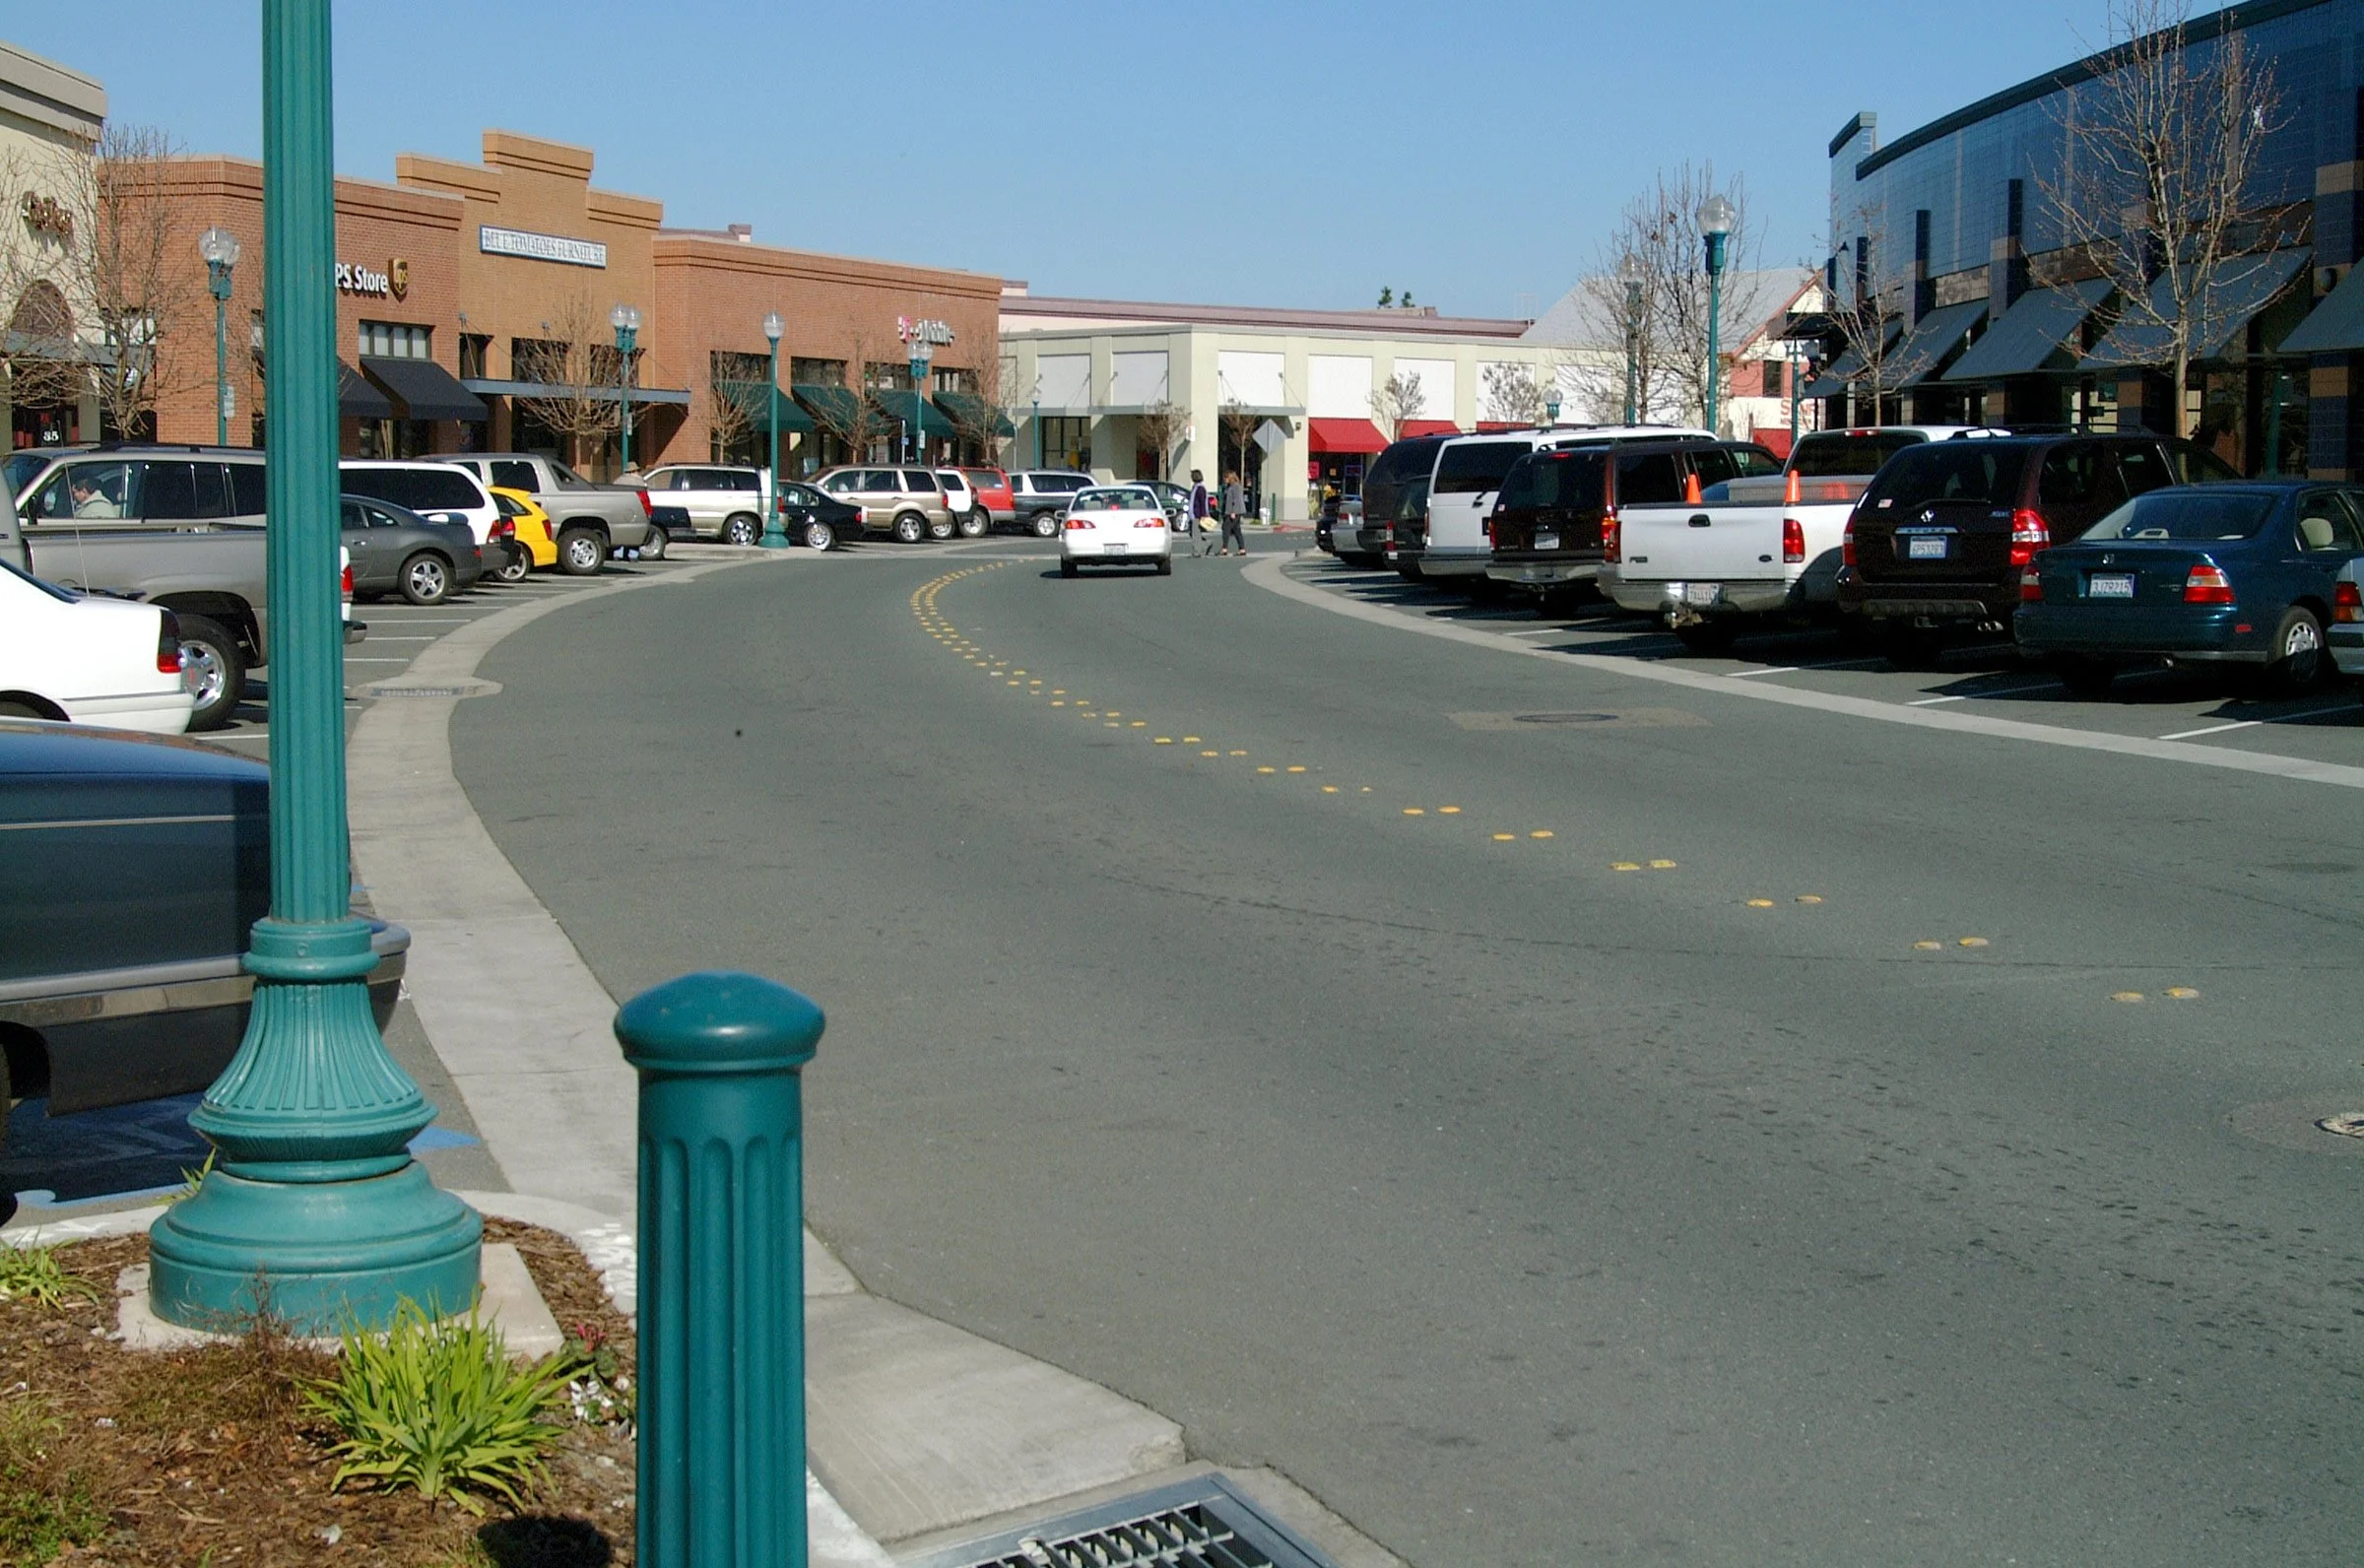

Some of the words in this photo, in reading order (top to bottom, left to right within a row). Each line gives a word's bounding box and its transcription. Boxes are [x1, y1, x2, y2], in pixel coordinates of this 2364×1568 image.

[484, 229, 509, 250] BLUE
[510, 232, 558, 256] TOMATOES
[558, 240, 604, 263] FURNITURE
[335, 262, 353, 290] PS
[354, 265, 388, 293] Store
